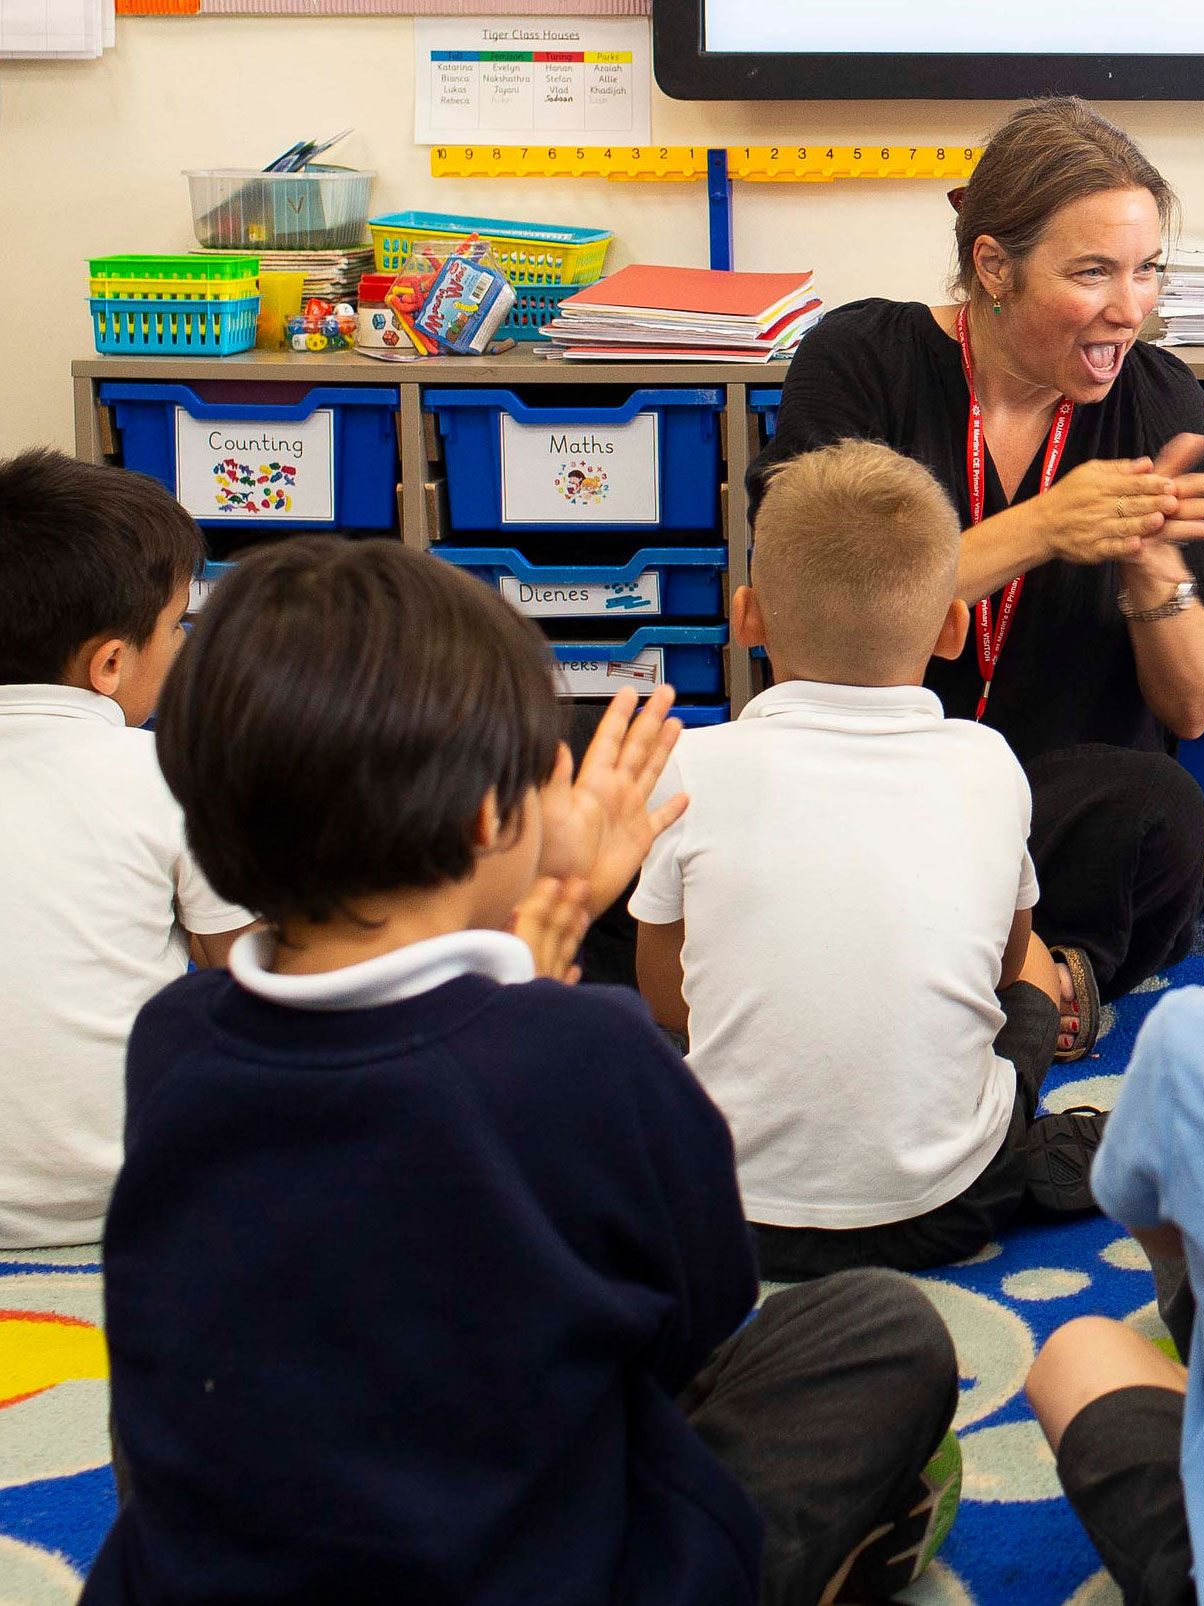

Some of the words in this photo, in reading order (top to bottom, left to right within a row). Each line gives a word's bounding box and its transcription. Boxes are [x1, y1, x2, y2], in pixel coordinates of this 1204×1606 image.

[482, 29, 508, 41] Tiger
[512, 29, 539, 40] Class
[543, 30, 580, 40] Houses
[597, 53, 619, 61] Parks
[493, 64, 521, 73] Evelyn
[546, 74, 572, 83] Stefan
[549, 86, 569, 94] Vlad
[437, 149, 447, 159] 10
[465, 149, 473, 159] 9
[492, 149, 500, 159] 8
[520, 149, 528, 159] 7
[548, 149, 556, 159] 6
[576, 149, 584, 159] 5
[604, 149, 612, 159] 4
[632, 149, 640, 159] 3
[660, 149, 668, 159] 2
[771, 149, 778, 159] 2
[798, 149, 806, 159] 3
[826, 149, 834, 159] 4
[854, 149, 862, 159] 5
[881, 149, 889, 159] 6
[909, 149, 916, 159] 7
[936, 149, 945, 159] 8
[964, 149, 972, 159] 9
[209, 431, 303, 458] Counting
[549, 434, 614, 454] Maths
[972, 429, 980, 456] Martin's
[1046, 448, 1059, 475] Primary
[1053, 416, 1066, 444] VISITOR
[972, 458, 980, 468] CE
[972, 469, 980, 499] Primary
[519, 583, 589, 603] Dienes
[1007, 577, 1020, 602] Primary
[980, 599, 988, 627] Primary
[1004, 603, 1012, 614] CE
[982, 632, 991, 662] VISITOR
